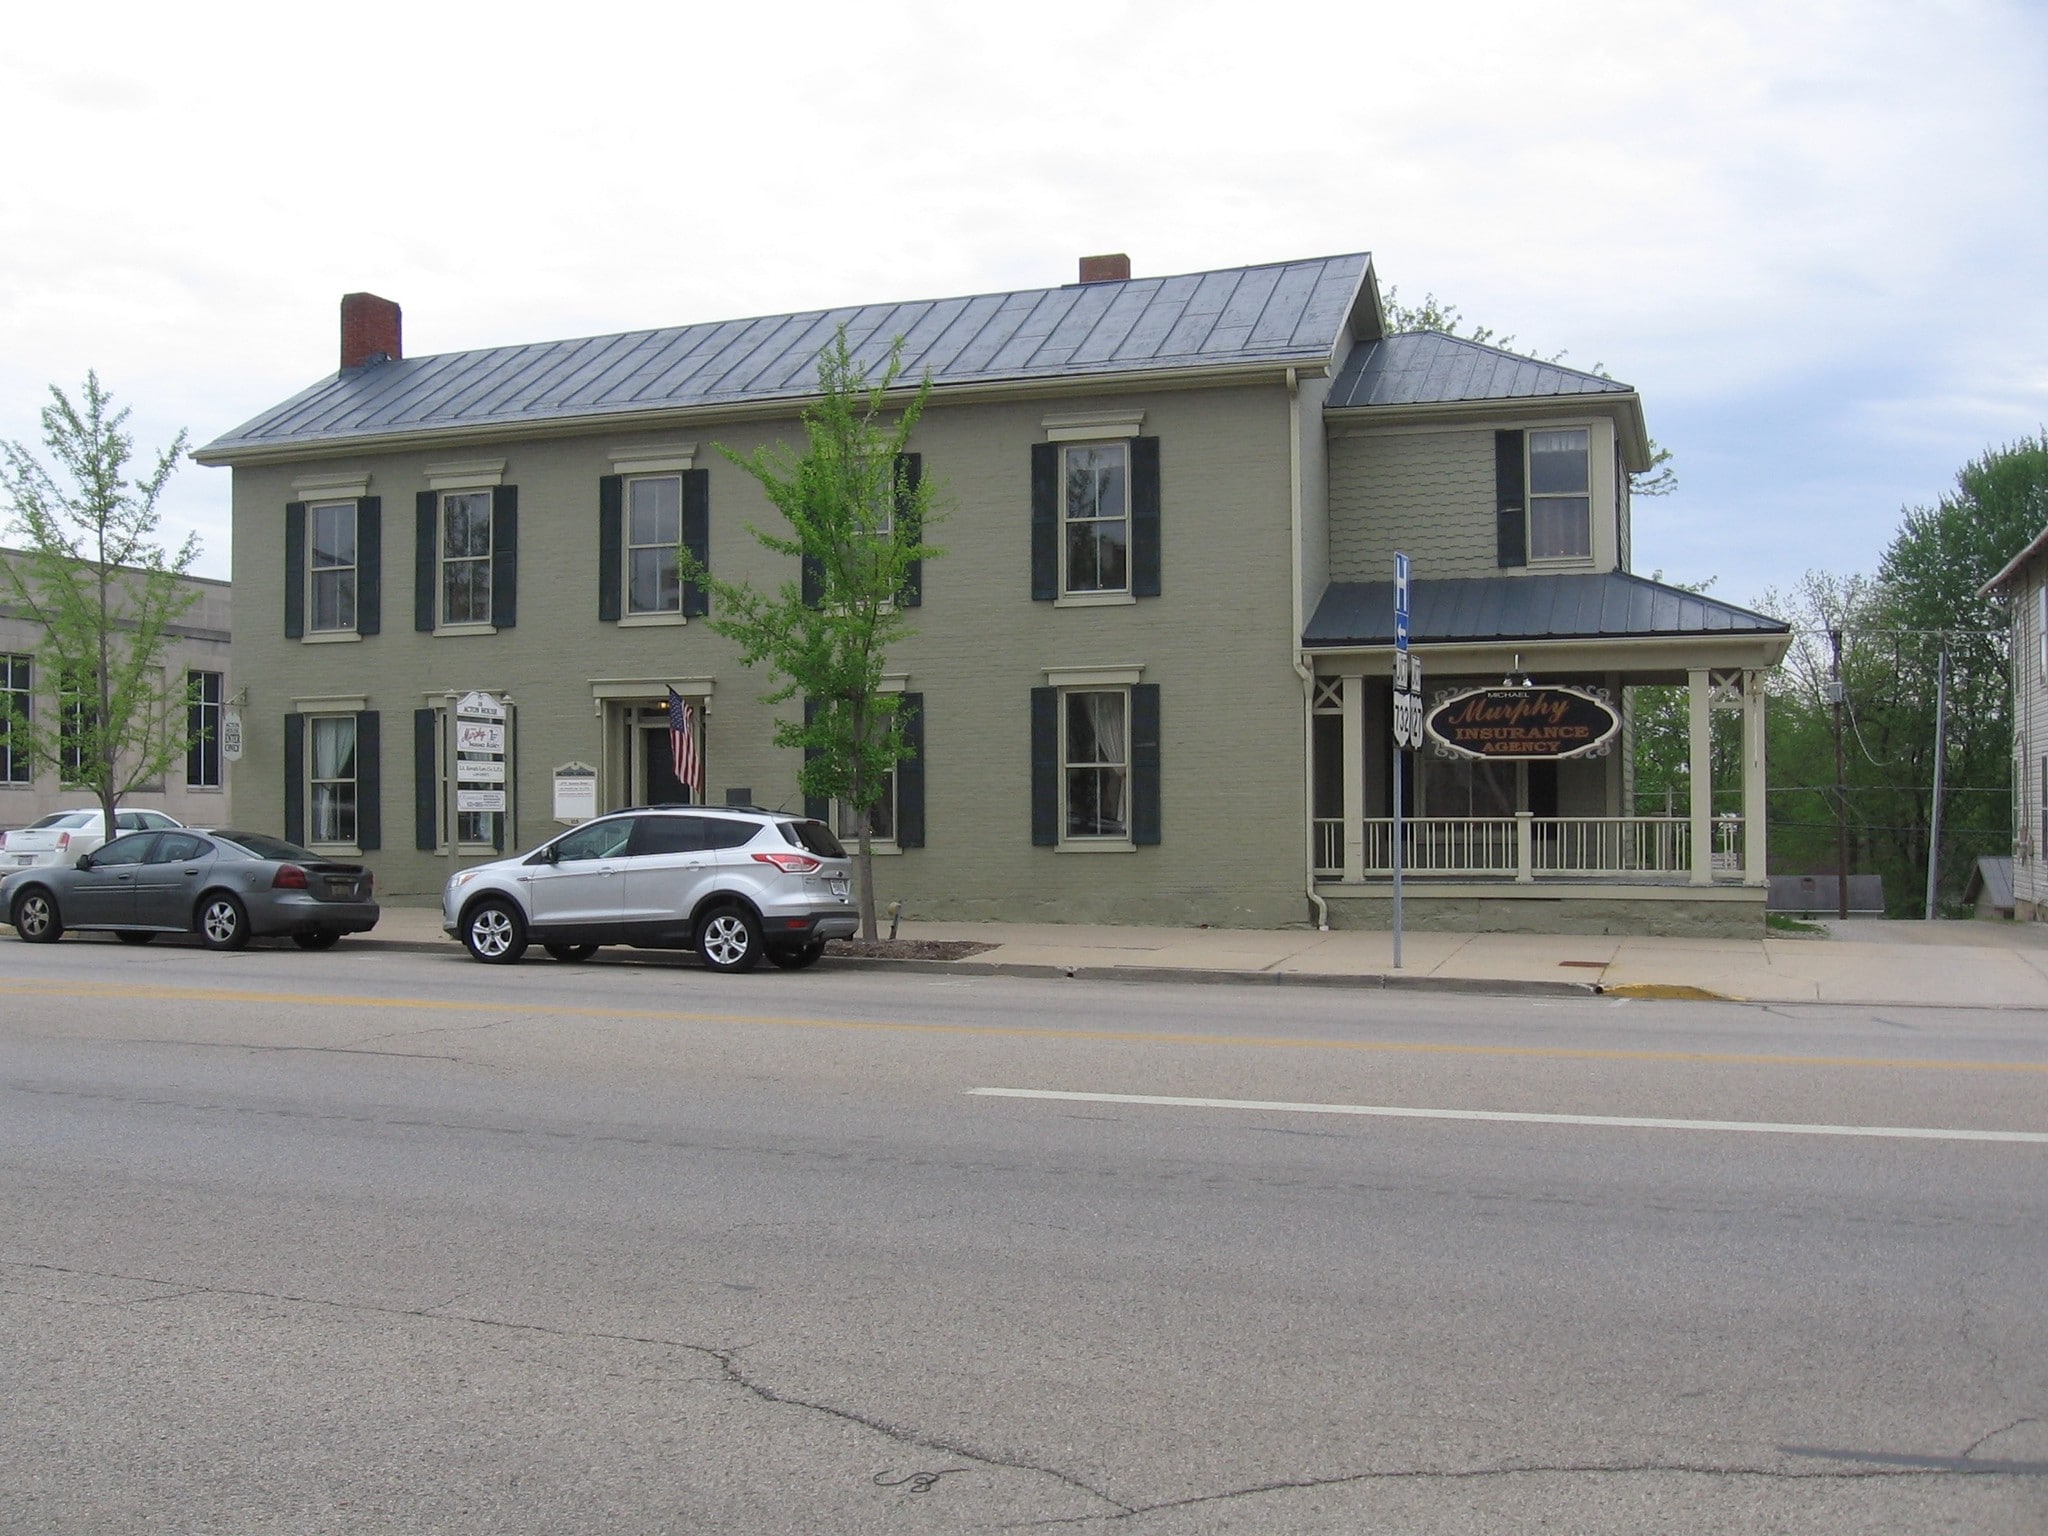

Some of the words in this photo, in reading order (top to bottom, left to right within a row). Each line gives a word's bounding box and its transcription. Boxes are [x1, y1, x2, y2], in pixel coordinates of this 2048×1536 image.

[1396, 557, 1407, 612] H
[1395, 704, 1409, 733] 732
[1448, 692, 1570, 725] Murphy
[1455, 726, 1590, 741] INSURANCE
[1481, 741, 1561, 753] AGENCY
